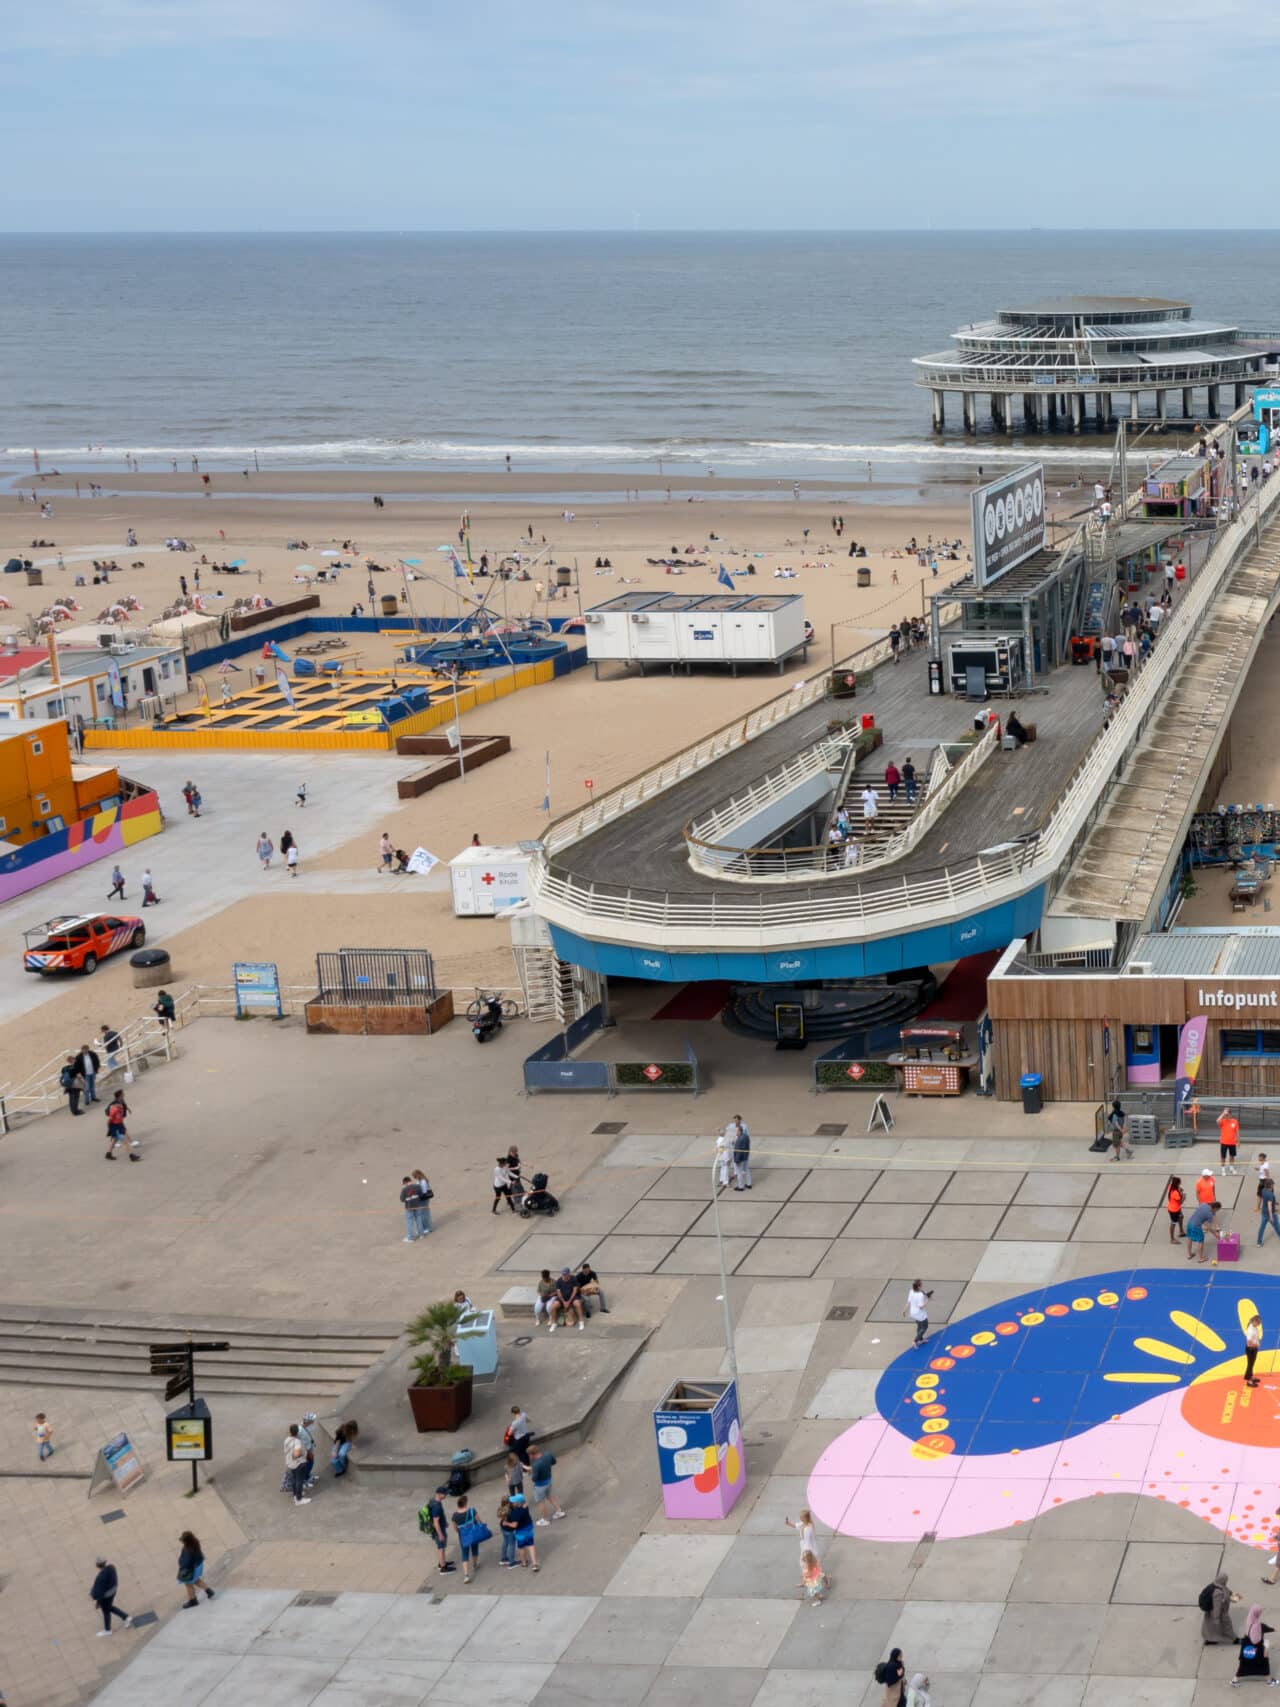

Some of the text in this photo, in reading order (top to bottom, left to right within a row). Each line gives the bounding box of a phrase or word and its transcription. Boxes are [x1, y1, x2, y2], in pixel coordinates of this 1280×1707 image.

[1199, 989, 1278, 1010] Infopunt
[1186, 1029, 1200, 1064] OPEN
[656, 1418, 697, 1426] Scheveningen
